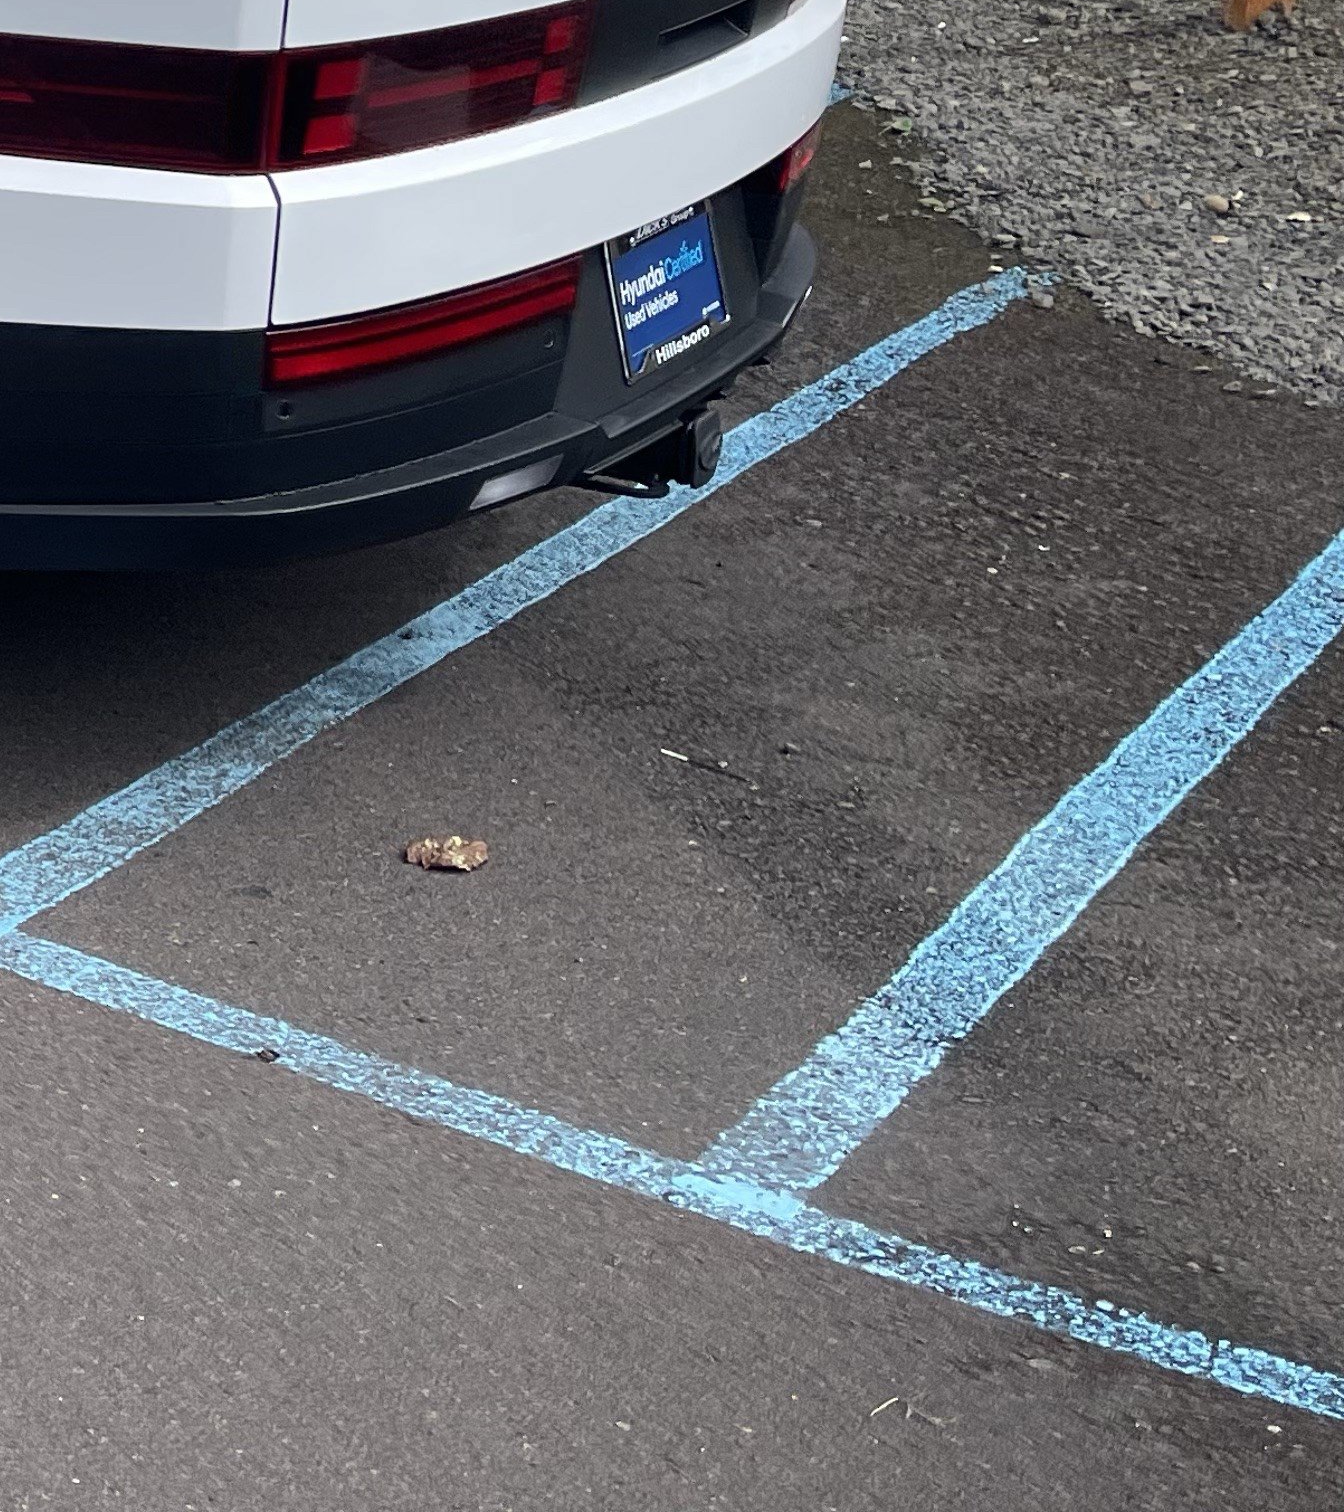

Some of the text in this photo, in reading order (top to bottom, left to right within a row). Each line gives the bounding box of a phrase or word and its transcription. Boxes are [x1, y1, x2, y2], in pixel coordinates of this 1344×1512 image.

[624, 302, 646, 330] Used
[644, 289, 679, 319] Vehicles
[655, 324, 710, 364] Hillsboro
